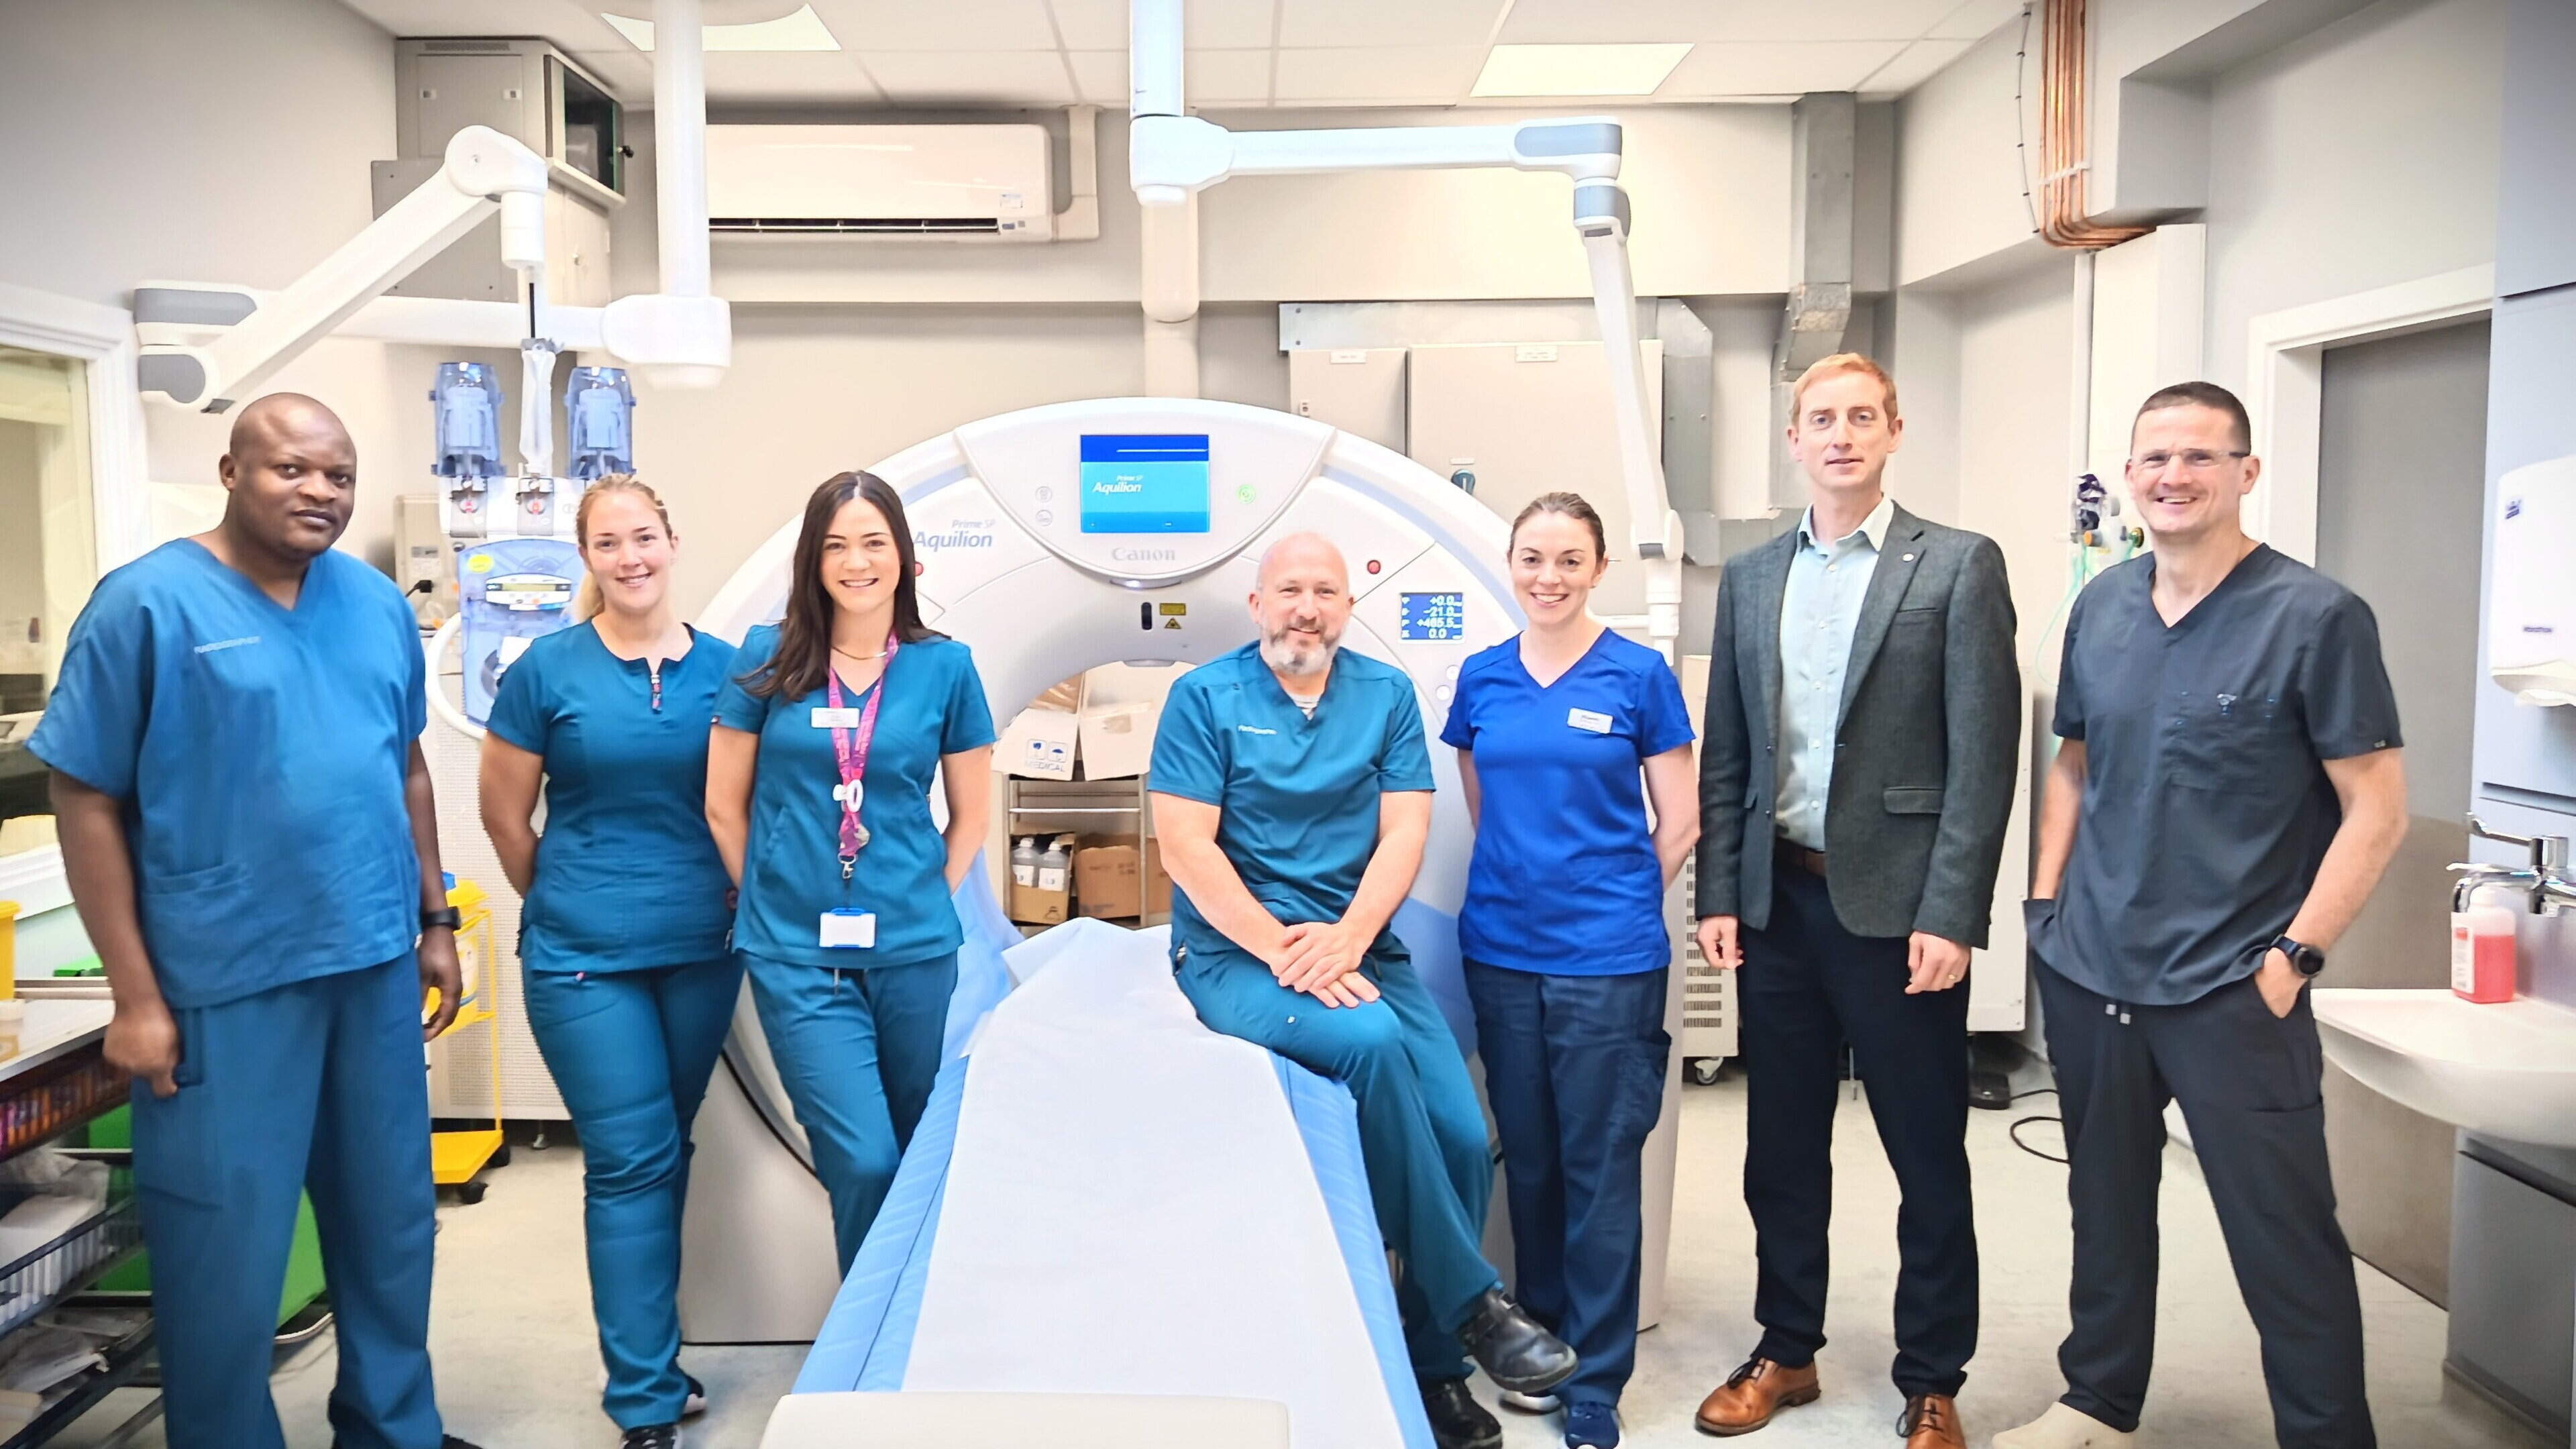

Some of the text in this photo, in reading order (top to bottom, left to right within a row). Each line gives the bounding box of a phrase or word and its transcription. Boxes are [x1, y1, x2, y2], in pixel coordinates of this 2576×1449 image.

[1093, 482, 1142, 496] Aquilion
[952, 519, 982, 528] Prime
[914, 531, 993, 552] Aquilion
[1112, 547, 1175, 561] Canon
